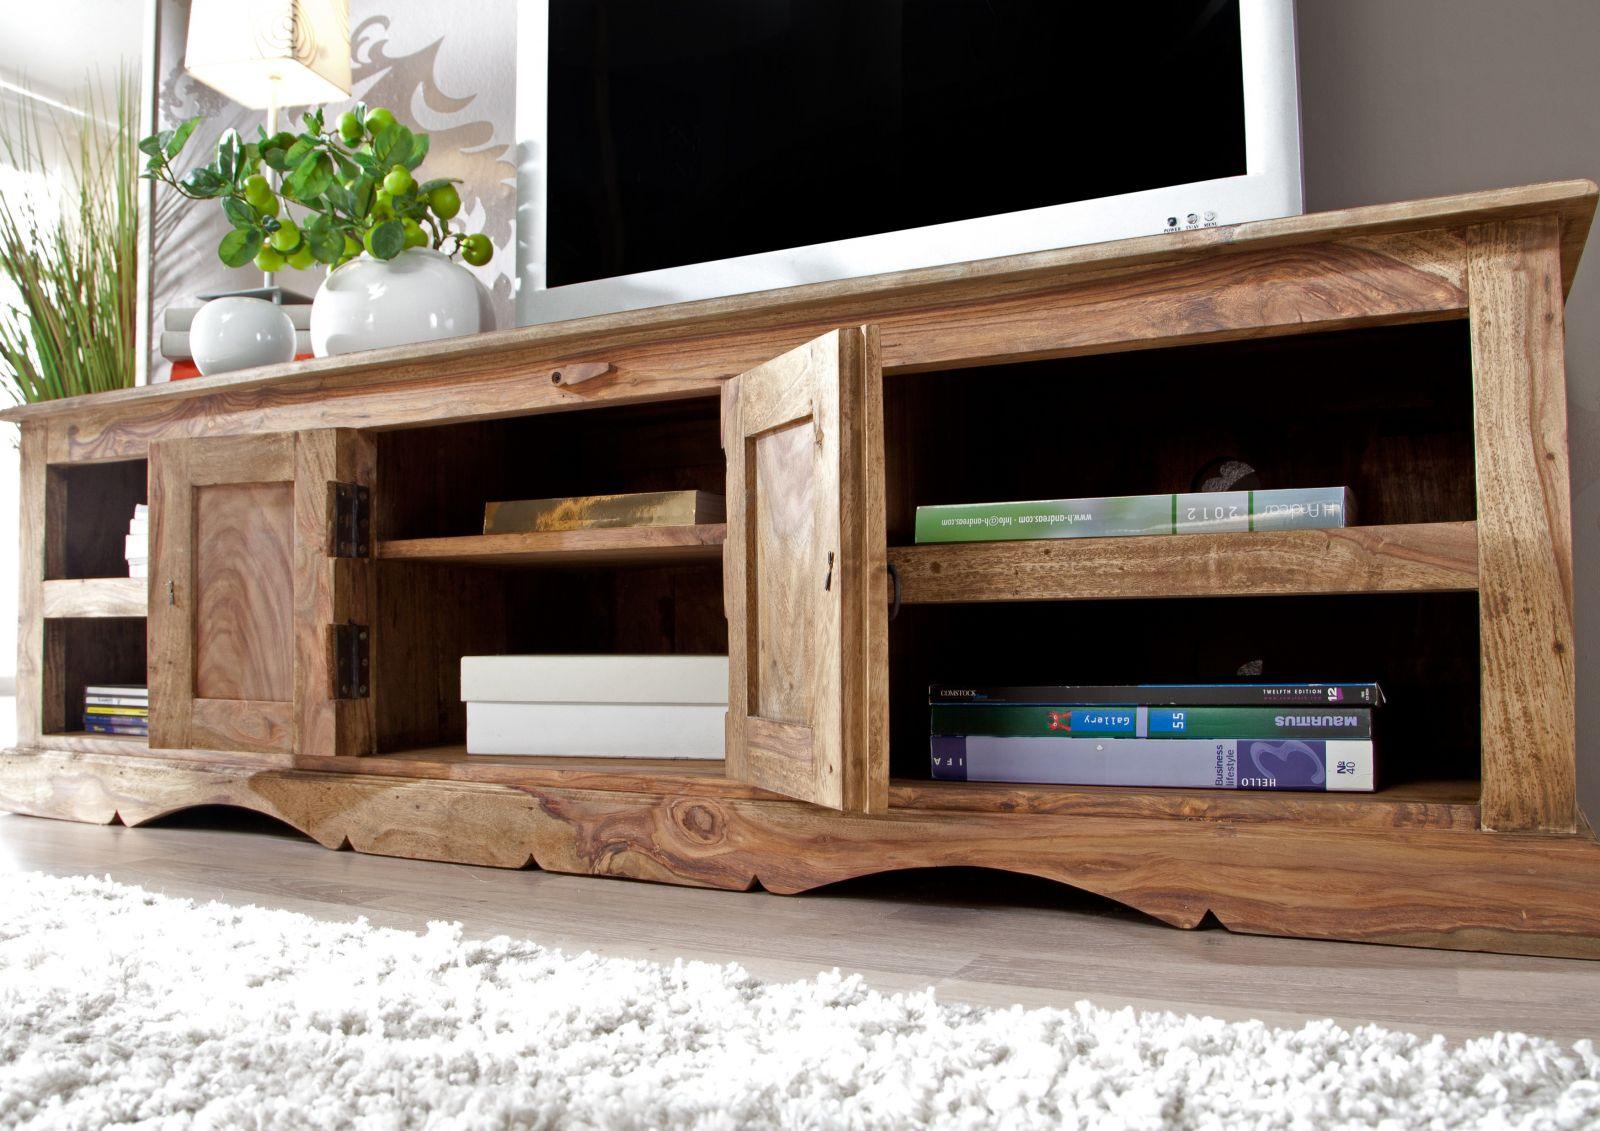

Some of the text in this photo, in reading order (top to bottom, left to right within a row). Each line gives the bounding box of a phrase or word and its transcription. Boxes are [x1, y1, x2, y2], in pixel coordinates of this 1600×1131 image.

[942, 513, 1092, 527] www.h-andreas.com Info@h-andreas.com
[1187, 506, 1238, 520] 2012
[940, 689, 976, 697] COMSTOCK
[1327, 687, 1338, 702] 12
[1084, 715, 1130, 726] Gallery
[1172, 712, 1184, 729] 55
[1215, 744, 1223, 786] Business
[1225, 749, 1236, 786] lifestyle
[1346, 761, 1356, 774] 40
[1241, 778, 1276, 787] HELLO
